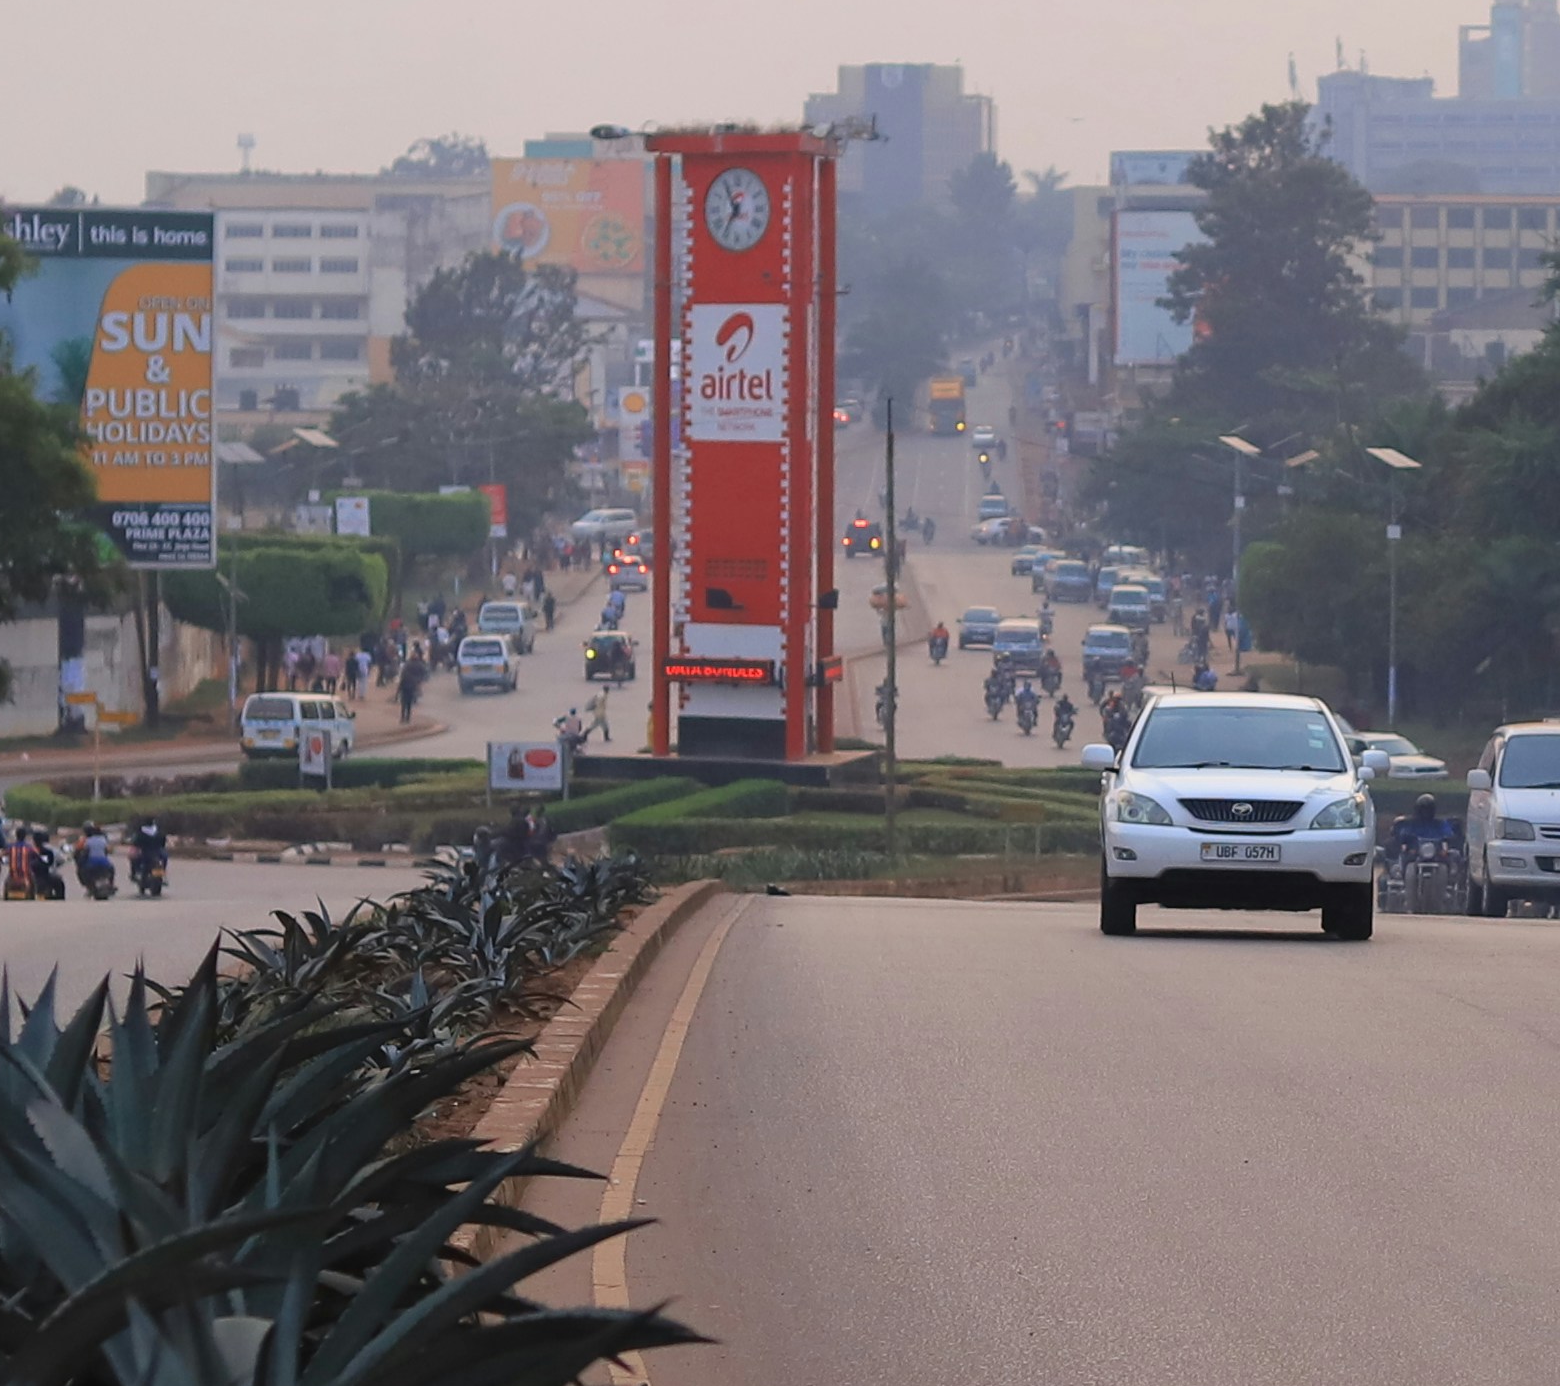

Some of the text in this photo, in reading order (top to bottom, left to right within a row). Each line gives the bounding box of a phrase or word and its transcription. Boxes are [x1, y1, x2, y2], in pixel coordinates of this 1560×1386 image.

[90, 224, 208, 246] this is home
[138, 296, 181, 311] OPEN
[100, 312, 211, 354] SUN
[144, 354, 170, 384] &
[701, 365, 773, 401] airtel
[85, 388, 210, 419] PUBLIC
[85, 420, 210, 445] HOLIDAYS
[112, 451, 139, 466] AM
[145, 451, 166, 466] TO
[184, 451, 209, 466] PM
[151, 511, 180, 527] 400
[183, 511, 210, 527] 400
[126, 527, 210, 540] PRIME PLAZA
[1216, 845, 1275, 859] UBF 057H
